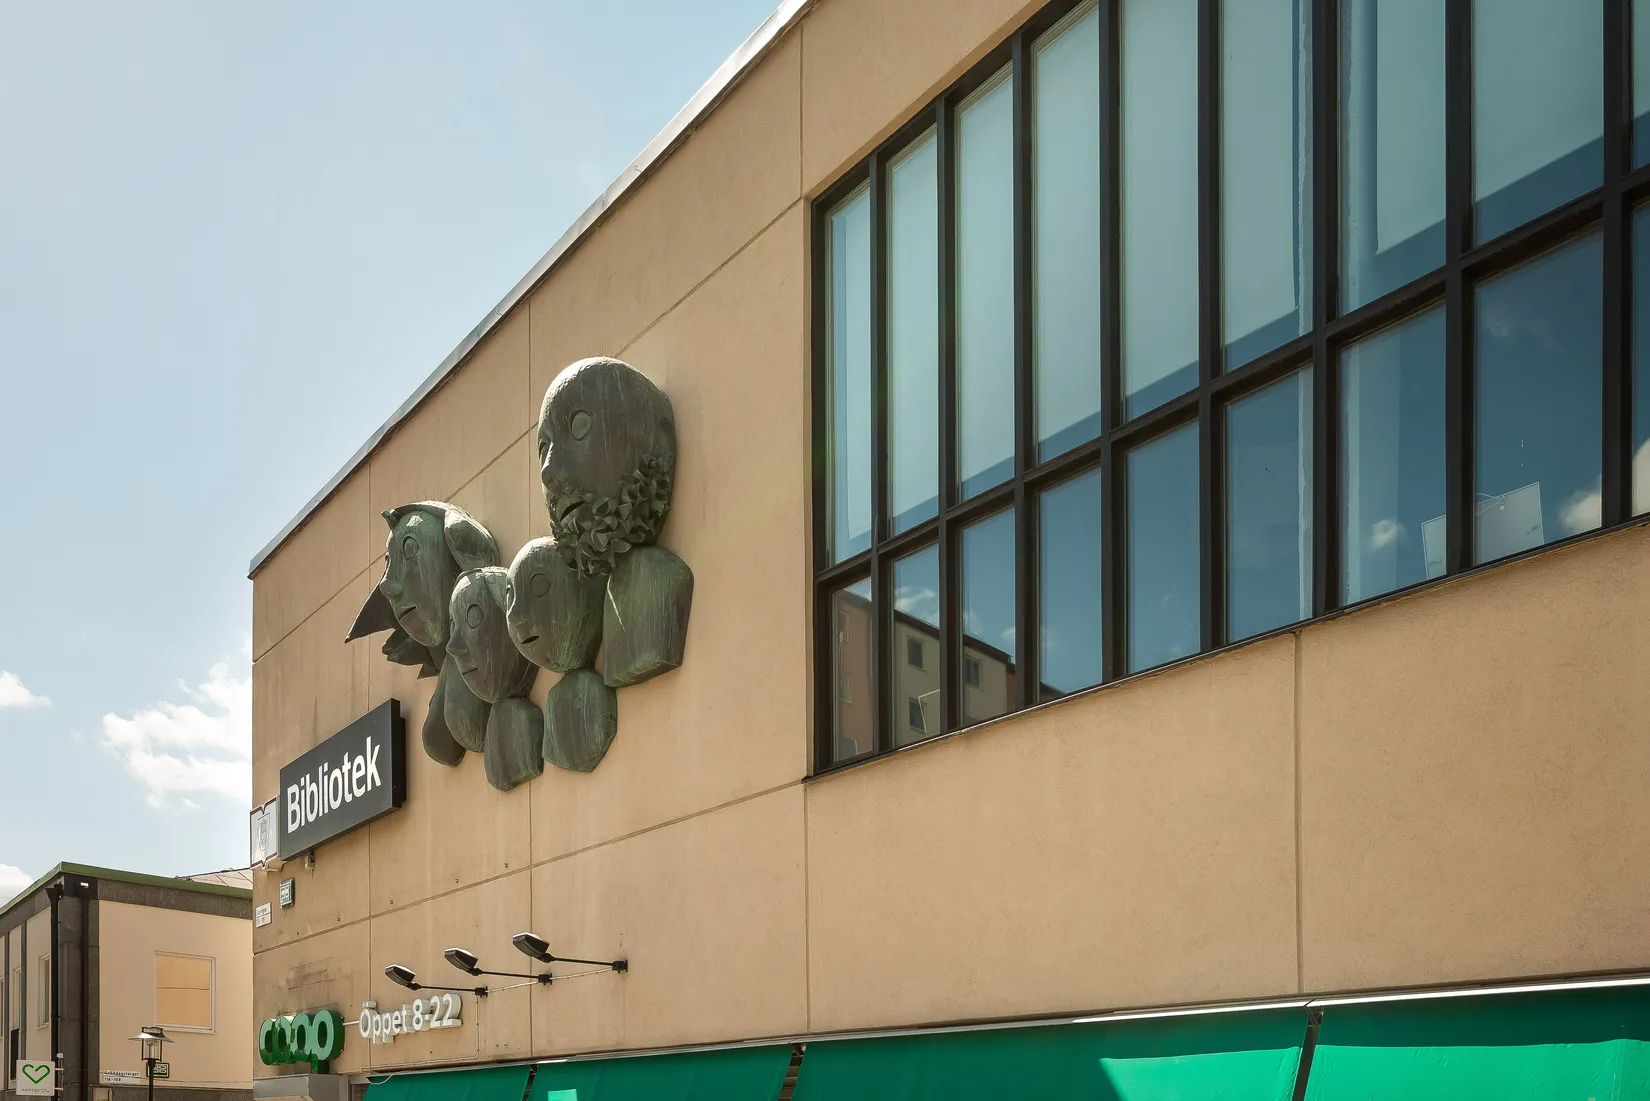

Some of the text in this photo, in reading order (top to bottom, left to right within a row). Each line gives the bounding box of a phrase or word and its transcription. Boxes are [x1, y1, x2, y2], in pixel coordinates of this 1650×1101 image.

[287, 736, 381, 834] Bibliotek
[359, 993, 463, 1044] Öppet 8-22
